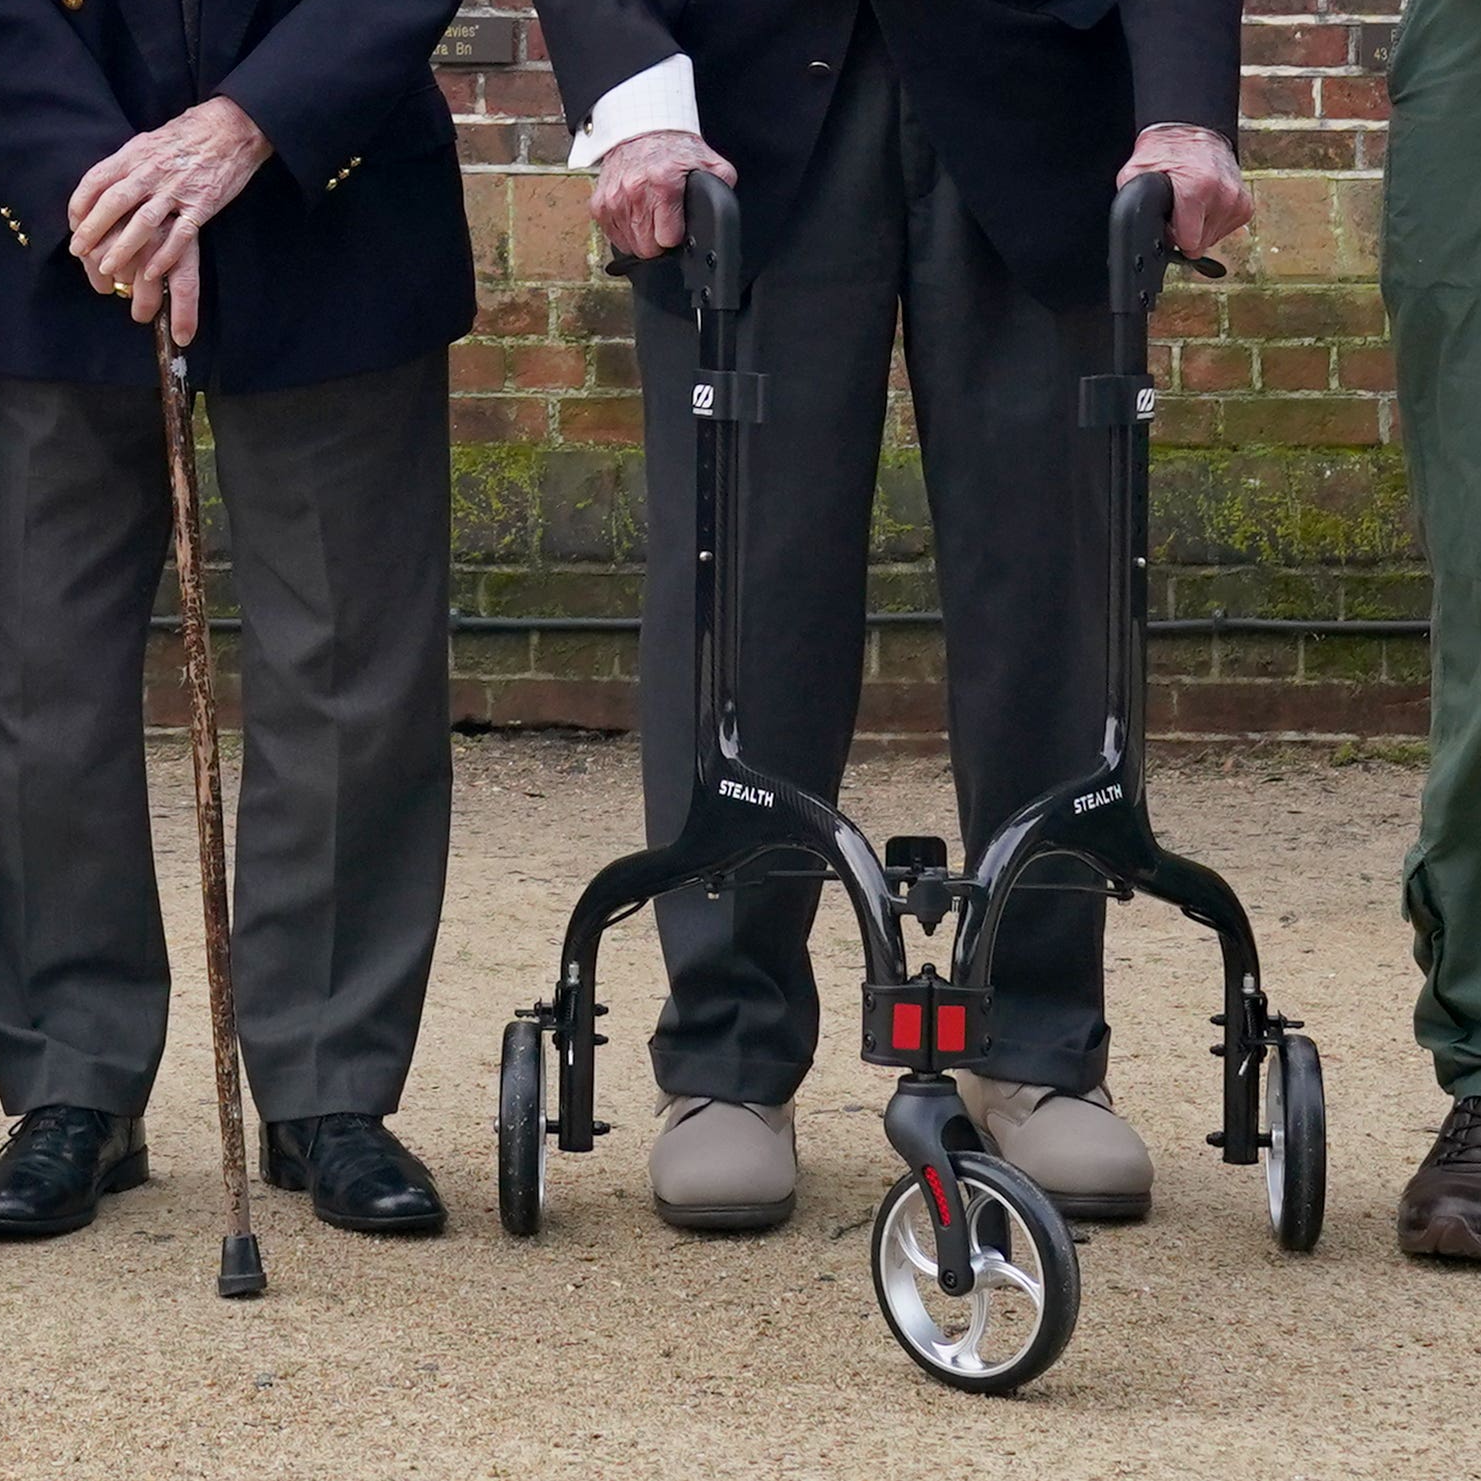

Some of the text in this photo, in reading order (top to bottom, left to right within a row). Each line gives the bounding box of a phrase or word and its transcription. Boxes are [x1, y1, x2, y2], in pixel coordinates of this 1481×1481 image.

[455, 41, 473, 56] Bn
[719, 779, 774, 808] STEALTH
[1073, 783, 1123, 815] STEALTH
